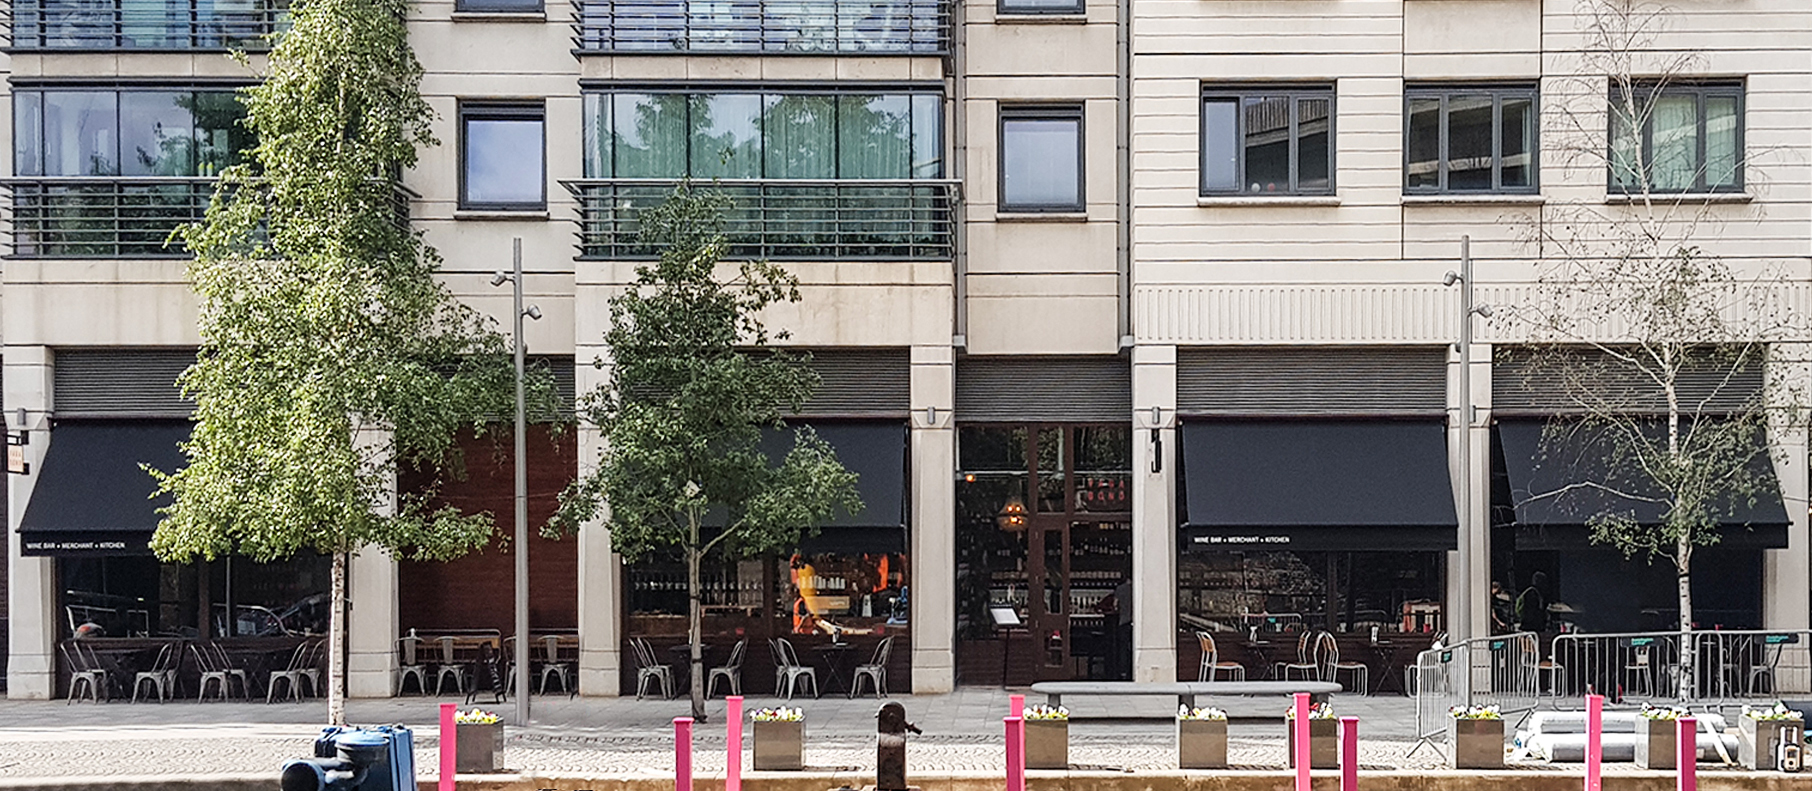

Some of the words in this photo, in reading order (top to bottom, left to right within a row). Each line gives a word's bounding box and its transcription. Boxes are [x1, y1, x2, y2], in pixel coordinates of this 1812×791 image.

[43, 542, 56, 550] BAR
[62, 542, 94, 550] MERCHANT
[100, 542, 125, 550] KITCHEN
